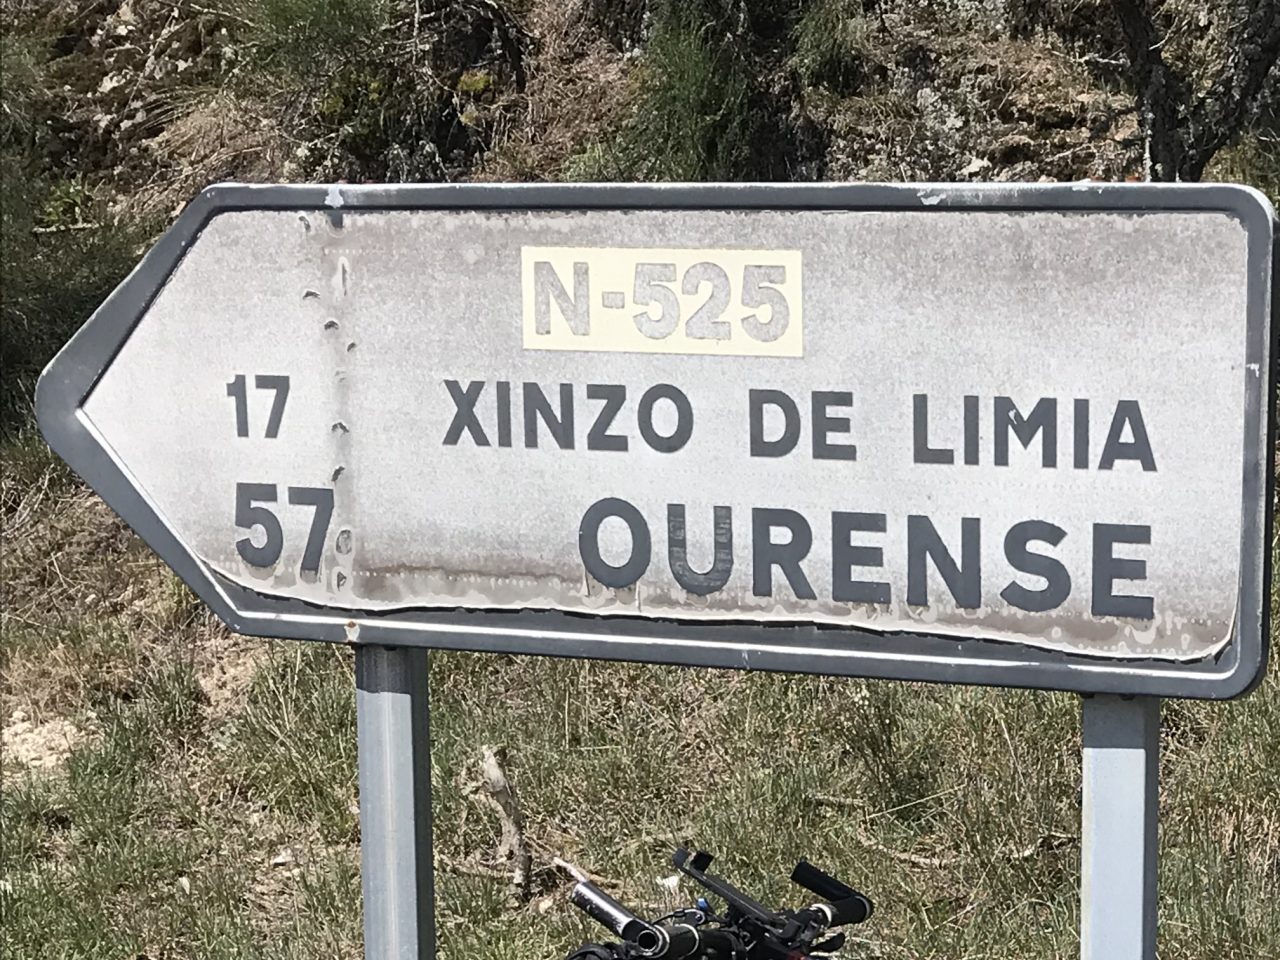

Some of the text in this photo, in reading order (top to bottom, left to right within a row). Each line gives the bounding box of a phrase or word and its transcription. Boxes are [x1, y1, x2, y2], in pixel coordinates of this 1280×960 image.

[532, 260, 791, 343] N-525
[226, 373, 291, 439] 17
[441, 378, 1158, 472] XINZO DE LIMIA
[234, 481, 336, 582] 57
[577, 495, 1156, 621] OURENSE
